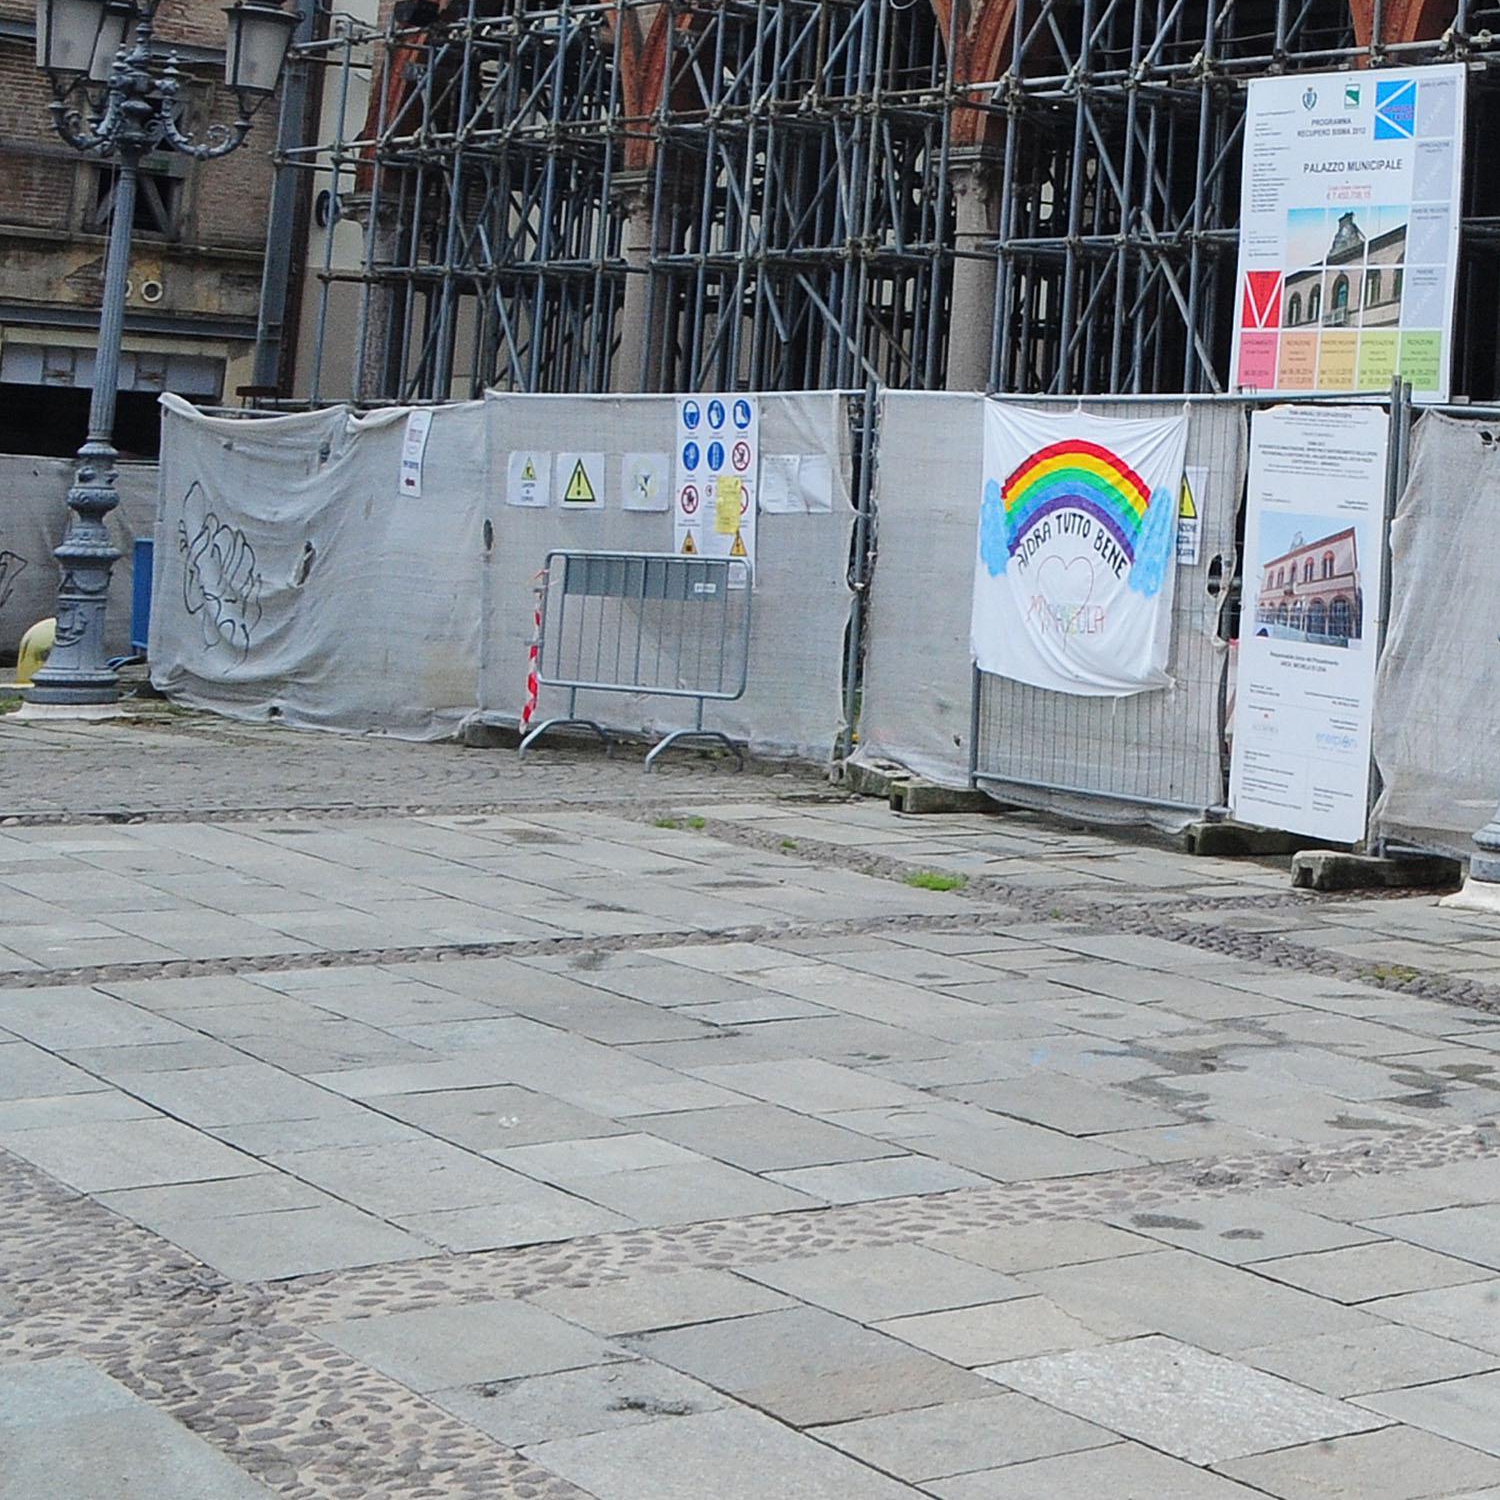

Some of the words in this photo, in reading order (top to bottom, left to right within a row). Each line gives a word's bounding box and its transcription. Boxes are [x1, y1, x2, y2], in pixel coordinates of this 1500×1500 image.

[1311, 118, 1352, 126] PROGRAMMA
[1297, 129, 1330, 138] RECUPERO
[1332, 128, 1351, 137] SISMA
[1303, 160, 1345, 173] PALAZZO
[1347, 158, 1403, 171] MUNICIPALE
[1055, 512, 1091, 539] TUTTO
[1093, 528, 1127, 581] BENE
